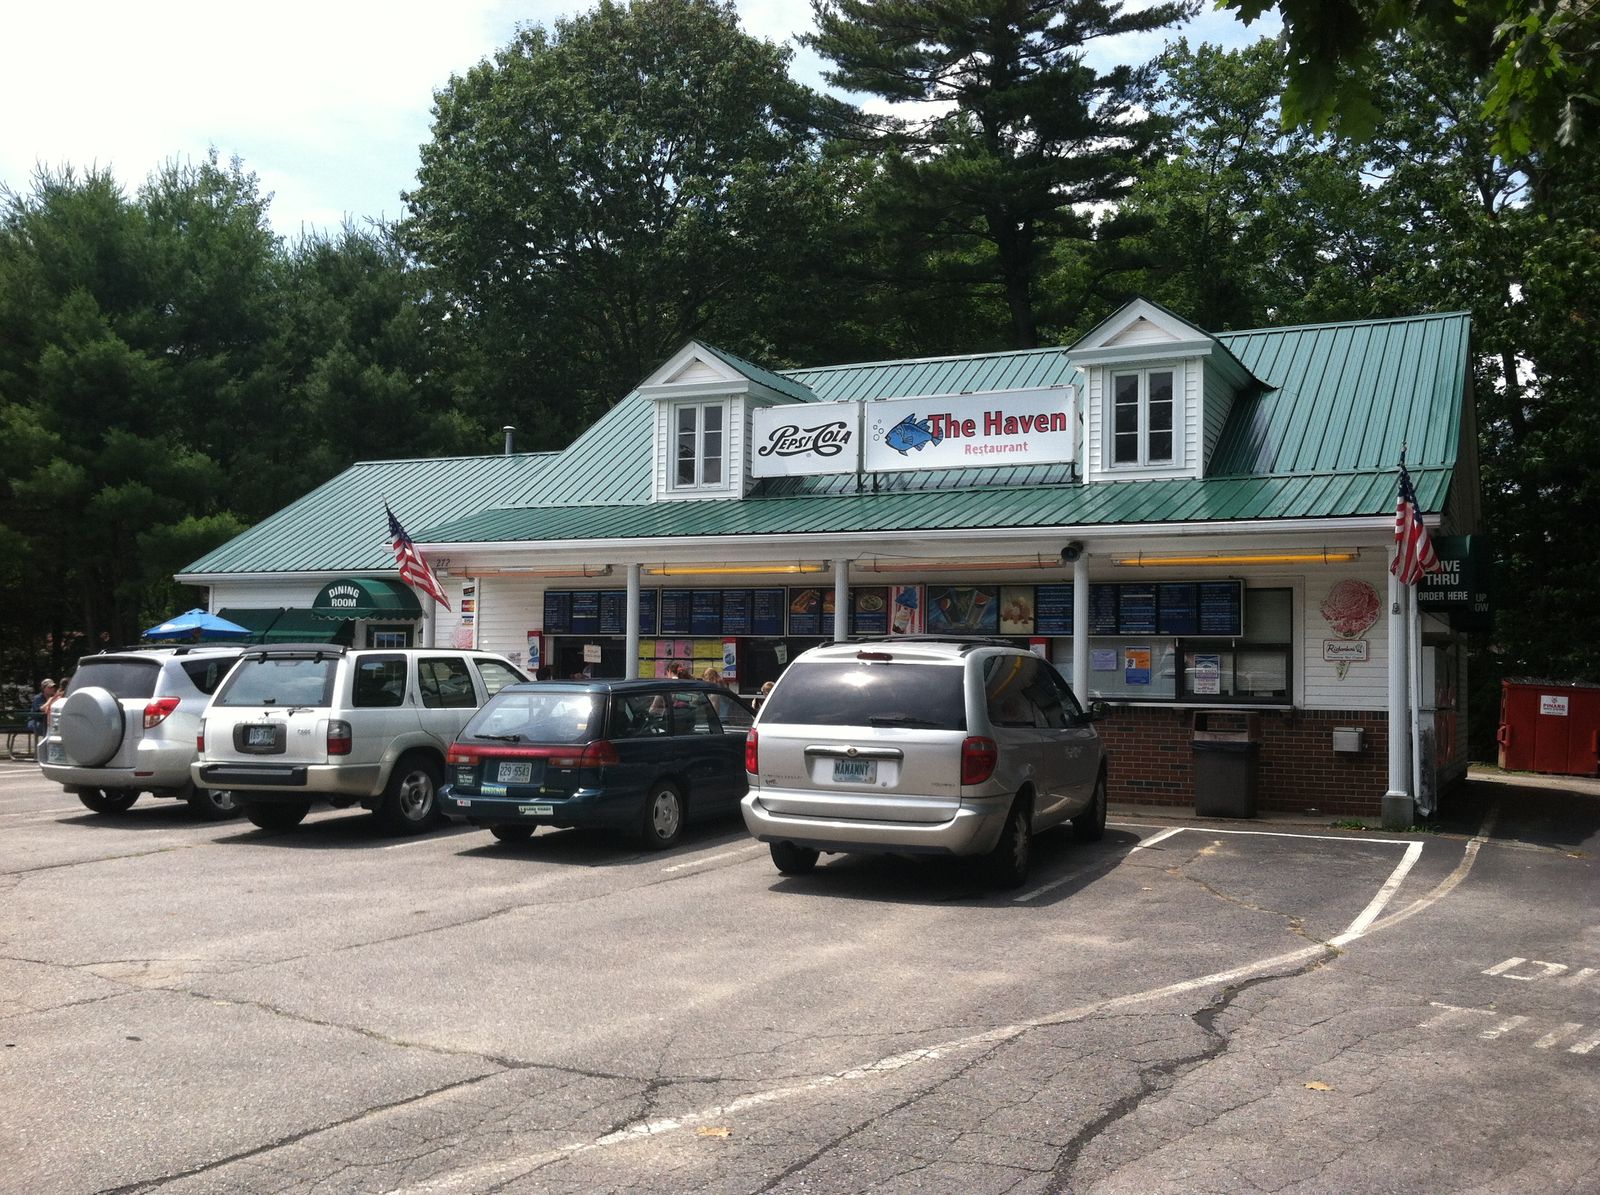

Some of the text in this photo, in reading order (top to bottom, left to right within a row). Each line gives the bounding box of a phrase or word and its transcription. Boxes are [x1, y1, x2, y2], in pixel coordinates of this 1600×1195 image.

[928, 411, 1067, 438] The Haven
[964, 441, 1028, 455] Restaurant
[1425, 573, 1459, 585] THRU
[328, 585, 360, 598] DINING
[1418, 591, 1468, 600] ORDER HERE
[331, 598, 357, 607] ROOM
[499, 766, 511, 777] 229
